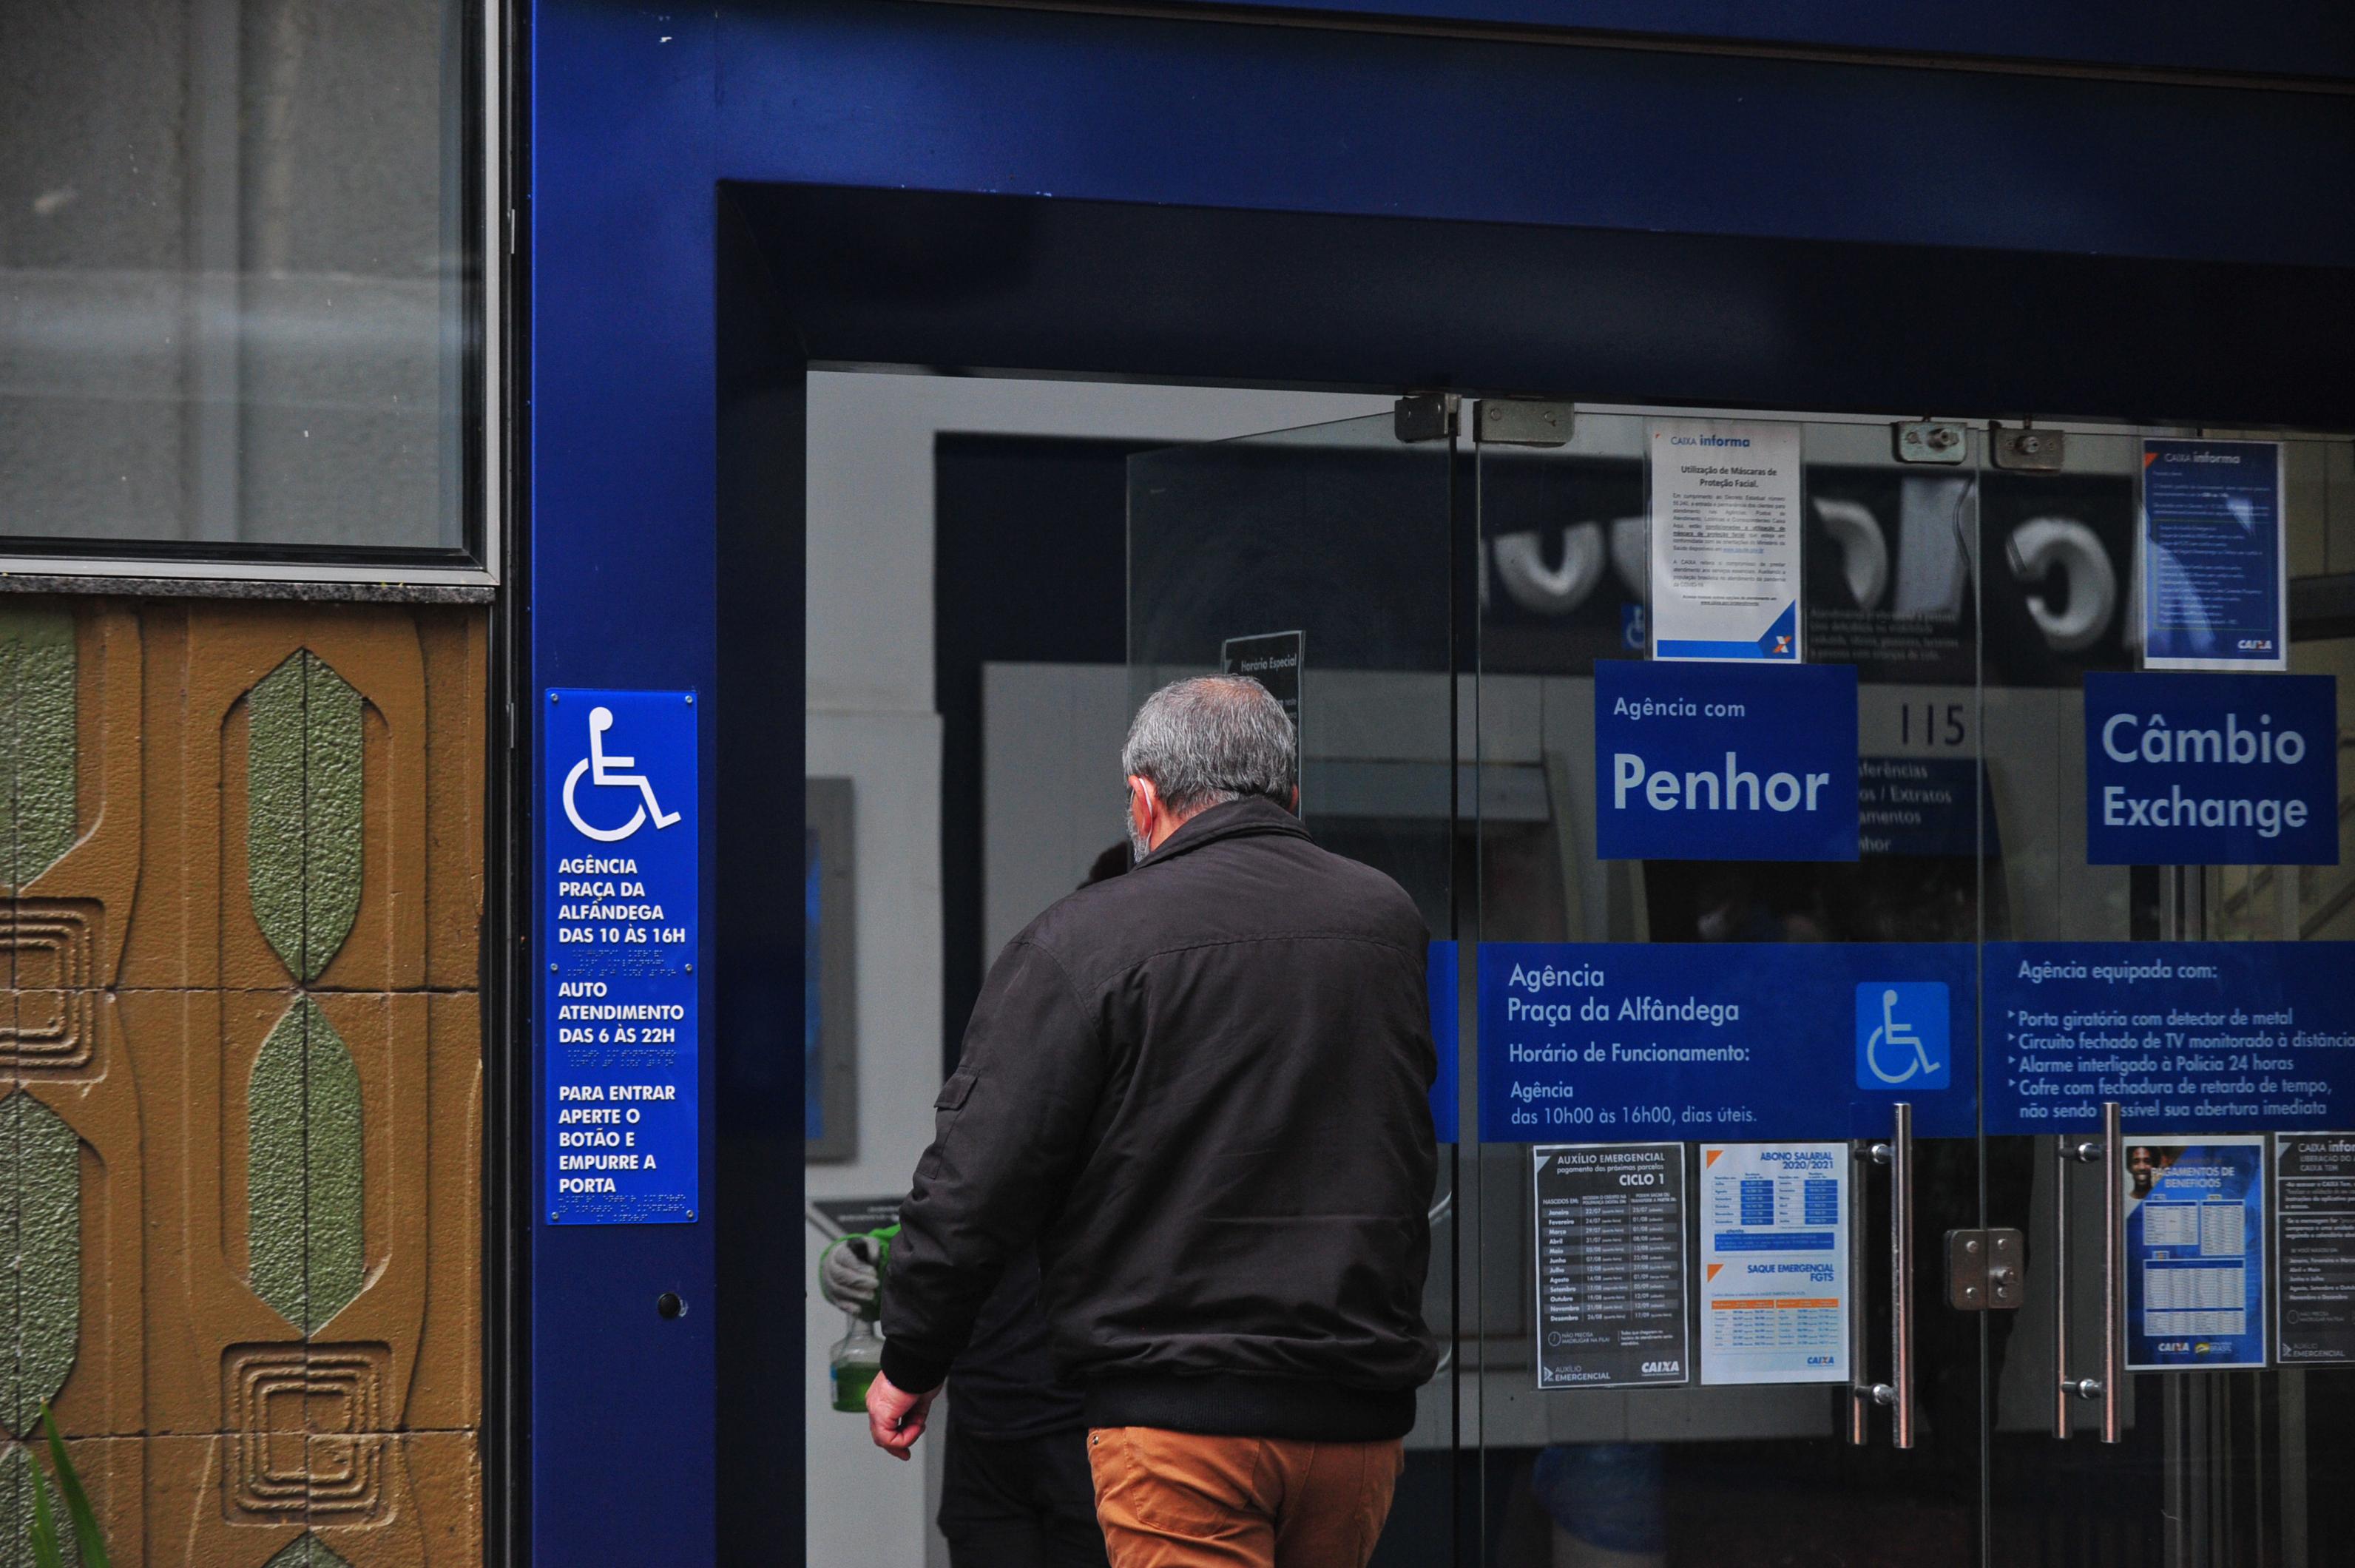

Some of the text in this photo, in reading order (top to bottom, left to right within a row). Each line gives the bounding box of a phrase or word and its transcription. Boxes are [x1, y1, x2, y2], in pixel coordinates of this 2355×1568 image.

[1671, 434, 1750, 447] CAIXA informa
[1680, 465, 1777, 476] Utilização de Máscaras de
[1700, 479, 1733, 489] Proteção
[2237, 639, 2272, 649] CAIXA
[1241, 652, 1297, 672] Horário Especial
[1613, 697, 1746, 720] Agência com
[1902, 704, 1965, 746] 115
[2102, 712, 2306, 765] Câmbio
[1614, 751, 1830, 812] Penhor
[1891, 785, 1953, 803] Extratos
[2104, 784, 2308, 838] Exchange
[558, 854, 638, 874] AGÊNCIA
[559, 882, 645, 902] PRAÇA DA
[558, 900, 664, 920] ALFÂNDEGA
[559, 924, 686, 944] DAS 10 ÀS 16H
[1508, 962, 1605, 993] Agência
[2018, 958, 2217, 984] Agência equipada com:
[558, 981, 607, 998] AUTO
[558, 1004, 684, 1021] ATENDIMENTO
[1508, 996, 1739, 1027] Praça da Alfândega
[2018, 1007, 2293, 1031] Porta giratória com detector de metal
[559, 1023, 675, 1044] DAS 6 ÀS 22H
[2018, 1033, 2075, 1050] Circuito
[2079, 1031, 2139, 1050] fechado
[2142, 1031, 2162, 1049] de
[2165, 1033, 2186, 1048] TV
[2189, 1030, 2274, 1049] monitorado
[2277, 1032, 2288, 1047] à
[1509, 1041, 1750, 1063] Horário de Funcionamento:
[2018, 1053, 2294, 1076] Alarme interligado à Polícia 24 horas
[559, 1085, 676, 1101] PARA ENTRAR
[1510, 1081, 1573, 1103] Agência
[2018, 1075, 2332, 1098] Cofre com fechadura de retardo de tempo,
[558, 1108, 641, 1125] APERTE O
[1511, 1105, 1758, 1126] das 10h00 às 16h00, dias úteis.
[2019, 1098, 2328, 1118] não sendo ssível sua abertura imediata
[559, 1128, 635, 1148] BOTÃO E
[559, 1155, 657, 1171] EMPURRE A
[1557, 1152, 1666, 1165] AUXÍLIO EMERGENCIAL
[1760, 1152, 1834, 1161] ABONO SALARIAL
[1783, 1161, 1834, 1170] 2020/2021
[1556, 1163, 1664, 1175] pagamento das próximas parcelas
[2220, 1166, 2236, 1176] DE
[559, 1178, 617, 1194] PORTA
[1619, 1173, 1664, 1186] CICLO 1
[1747, 1264, 1834, 1274] SAQUE EMERGENCIAL
[1810, 1274, 1834, 1282] FGTS
[2158, 1342, 2190, 1352] CAIXA
[1641, 1361, 1680, 1373] CAIXA
[1807, 1356, 1834, 1365] CAIXA
[1555, 1373, 1611, 1382] EMERGENCIAL
